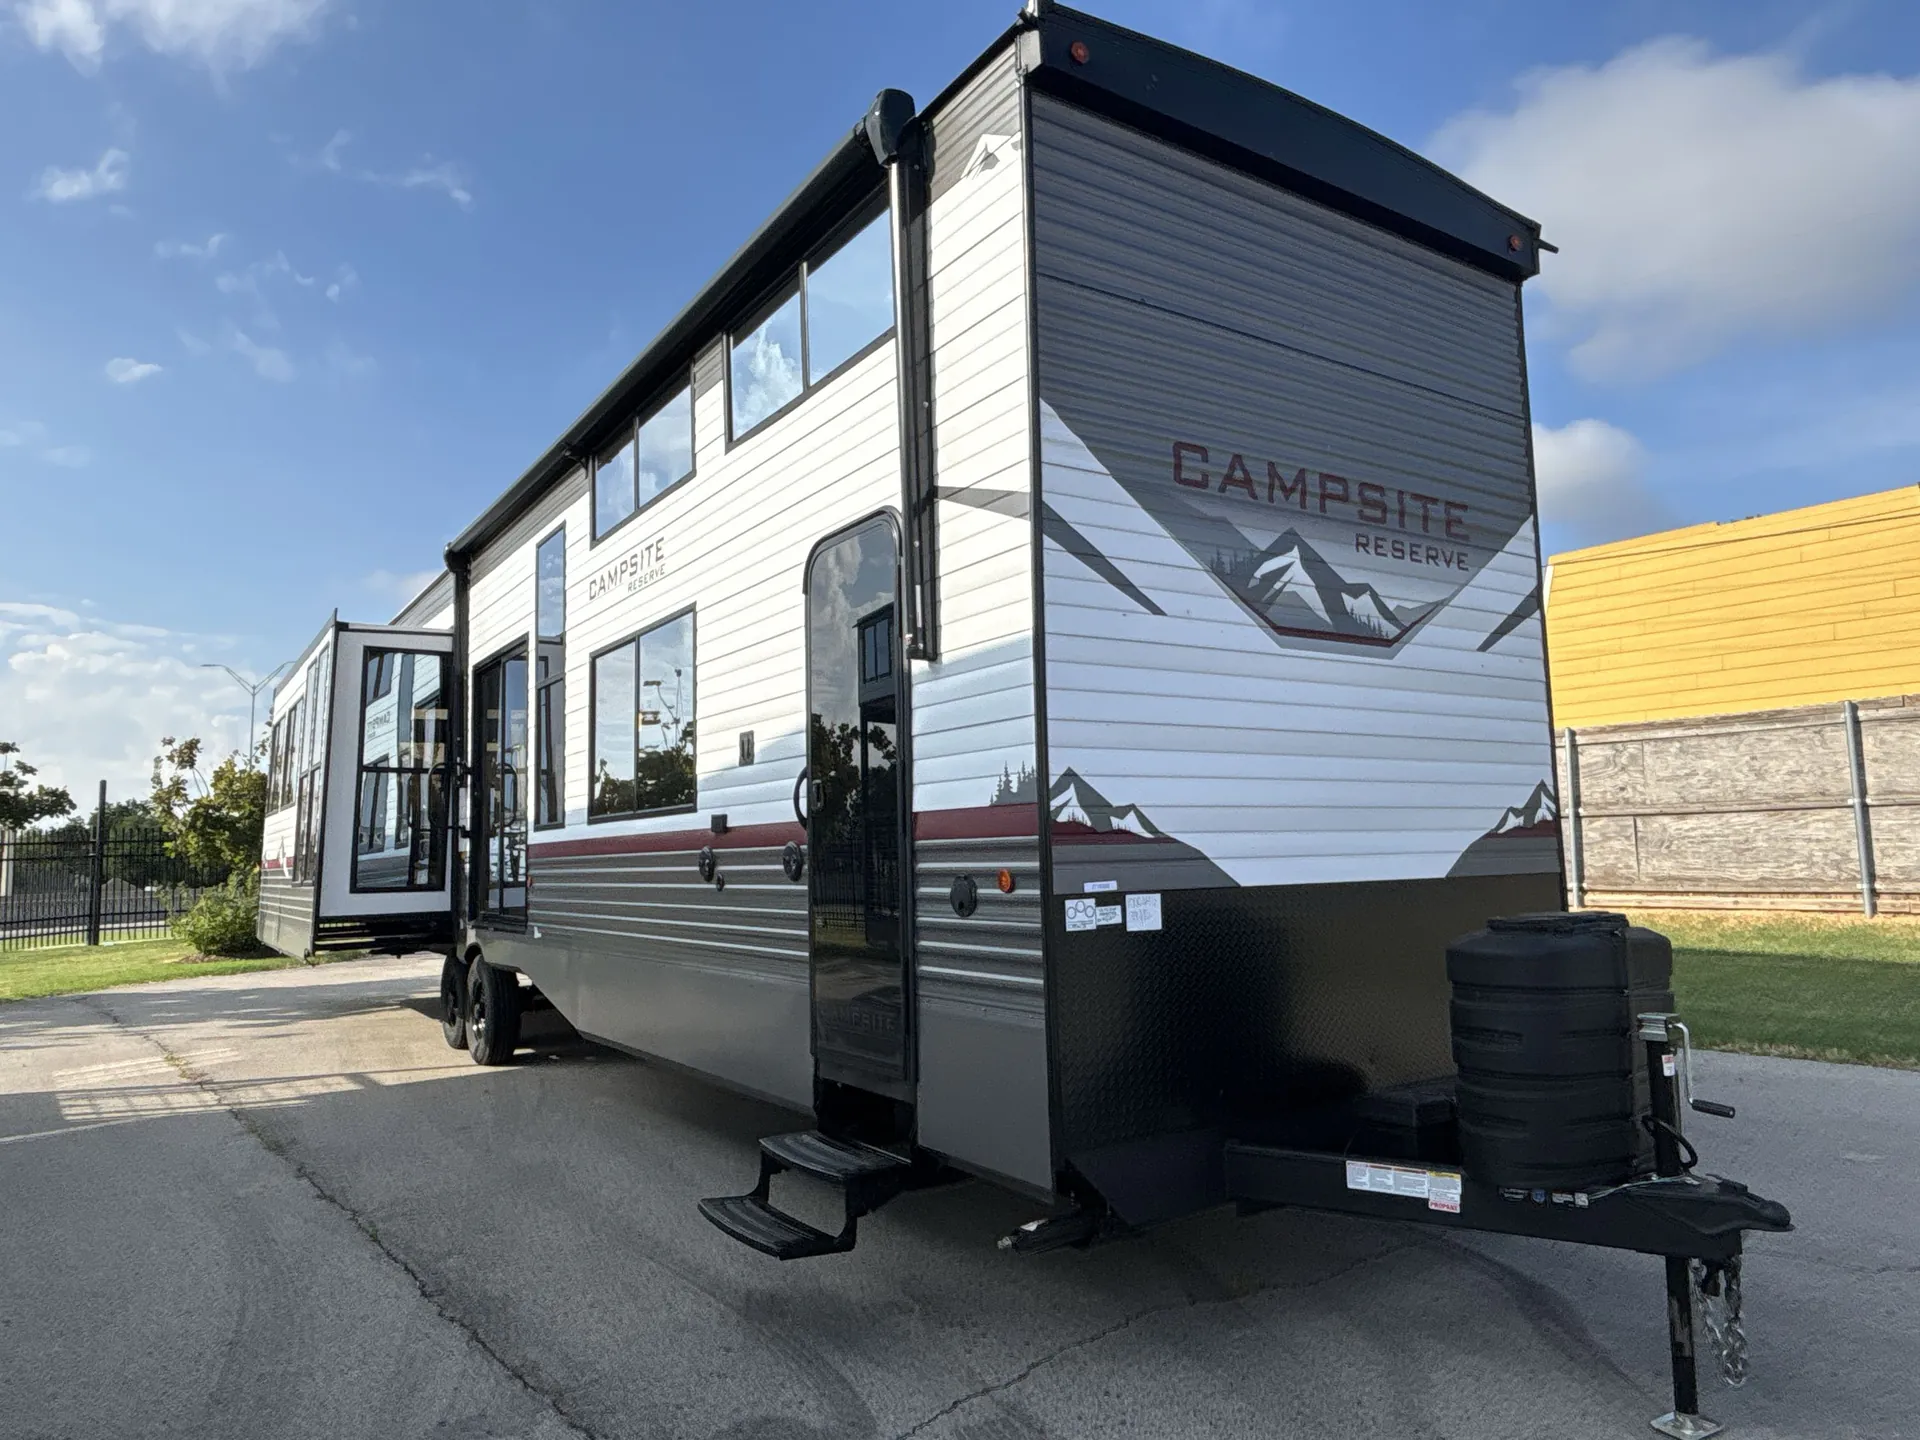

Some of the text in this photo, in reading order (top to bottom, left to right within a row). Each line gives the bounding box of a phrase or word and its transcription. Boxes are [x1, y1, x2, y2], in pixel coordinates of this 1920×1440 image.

[1172, 441, 1470, 541] CAMPSITE
[589, 536, 664, 601] CAMPSITE
[627, 563, 665, 592] RESERVE
[1355, 532, 1469, 571] RESERVE
